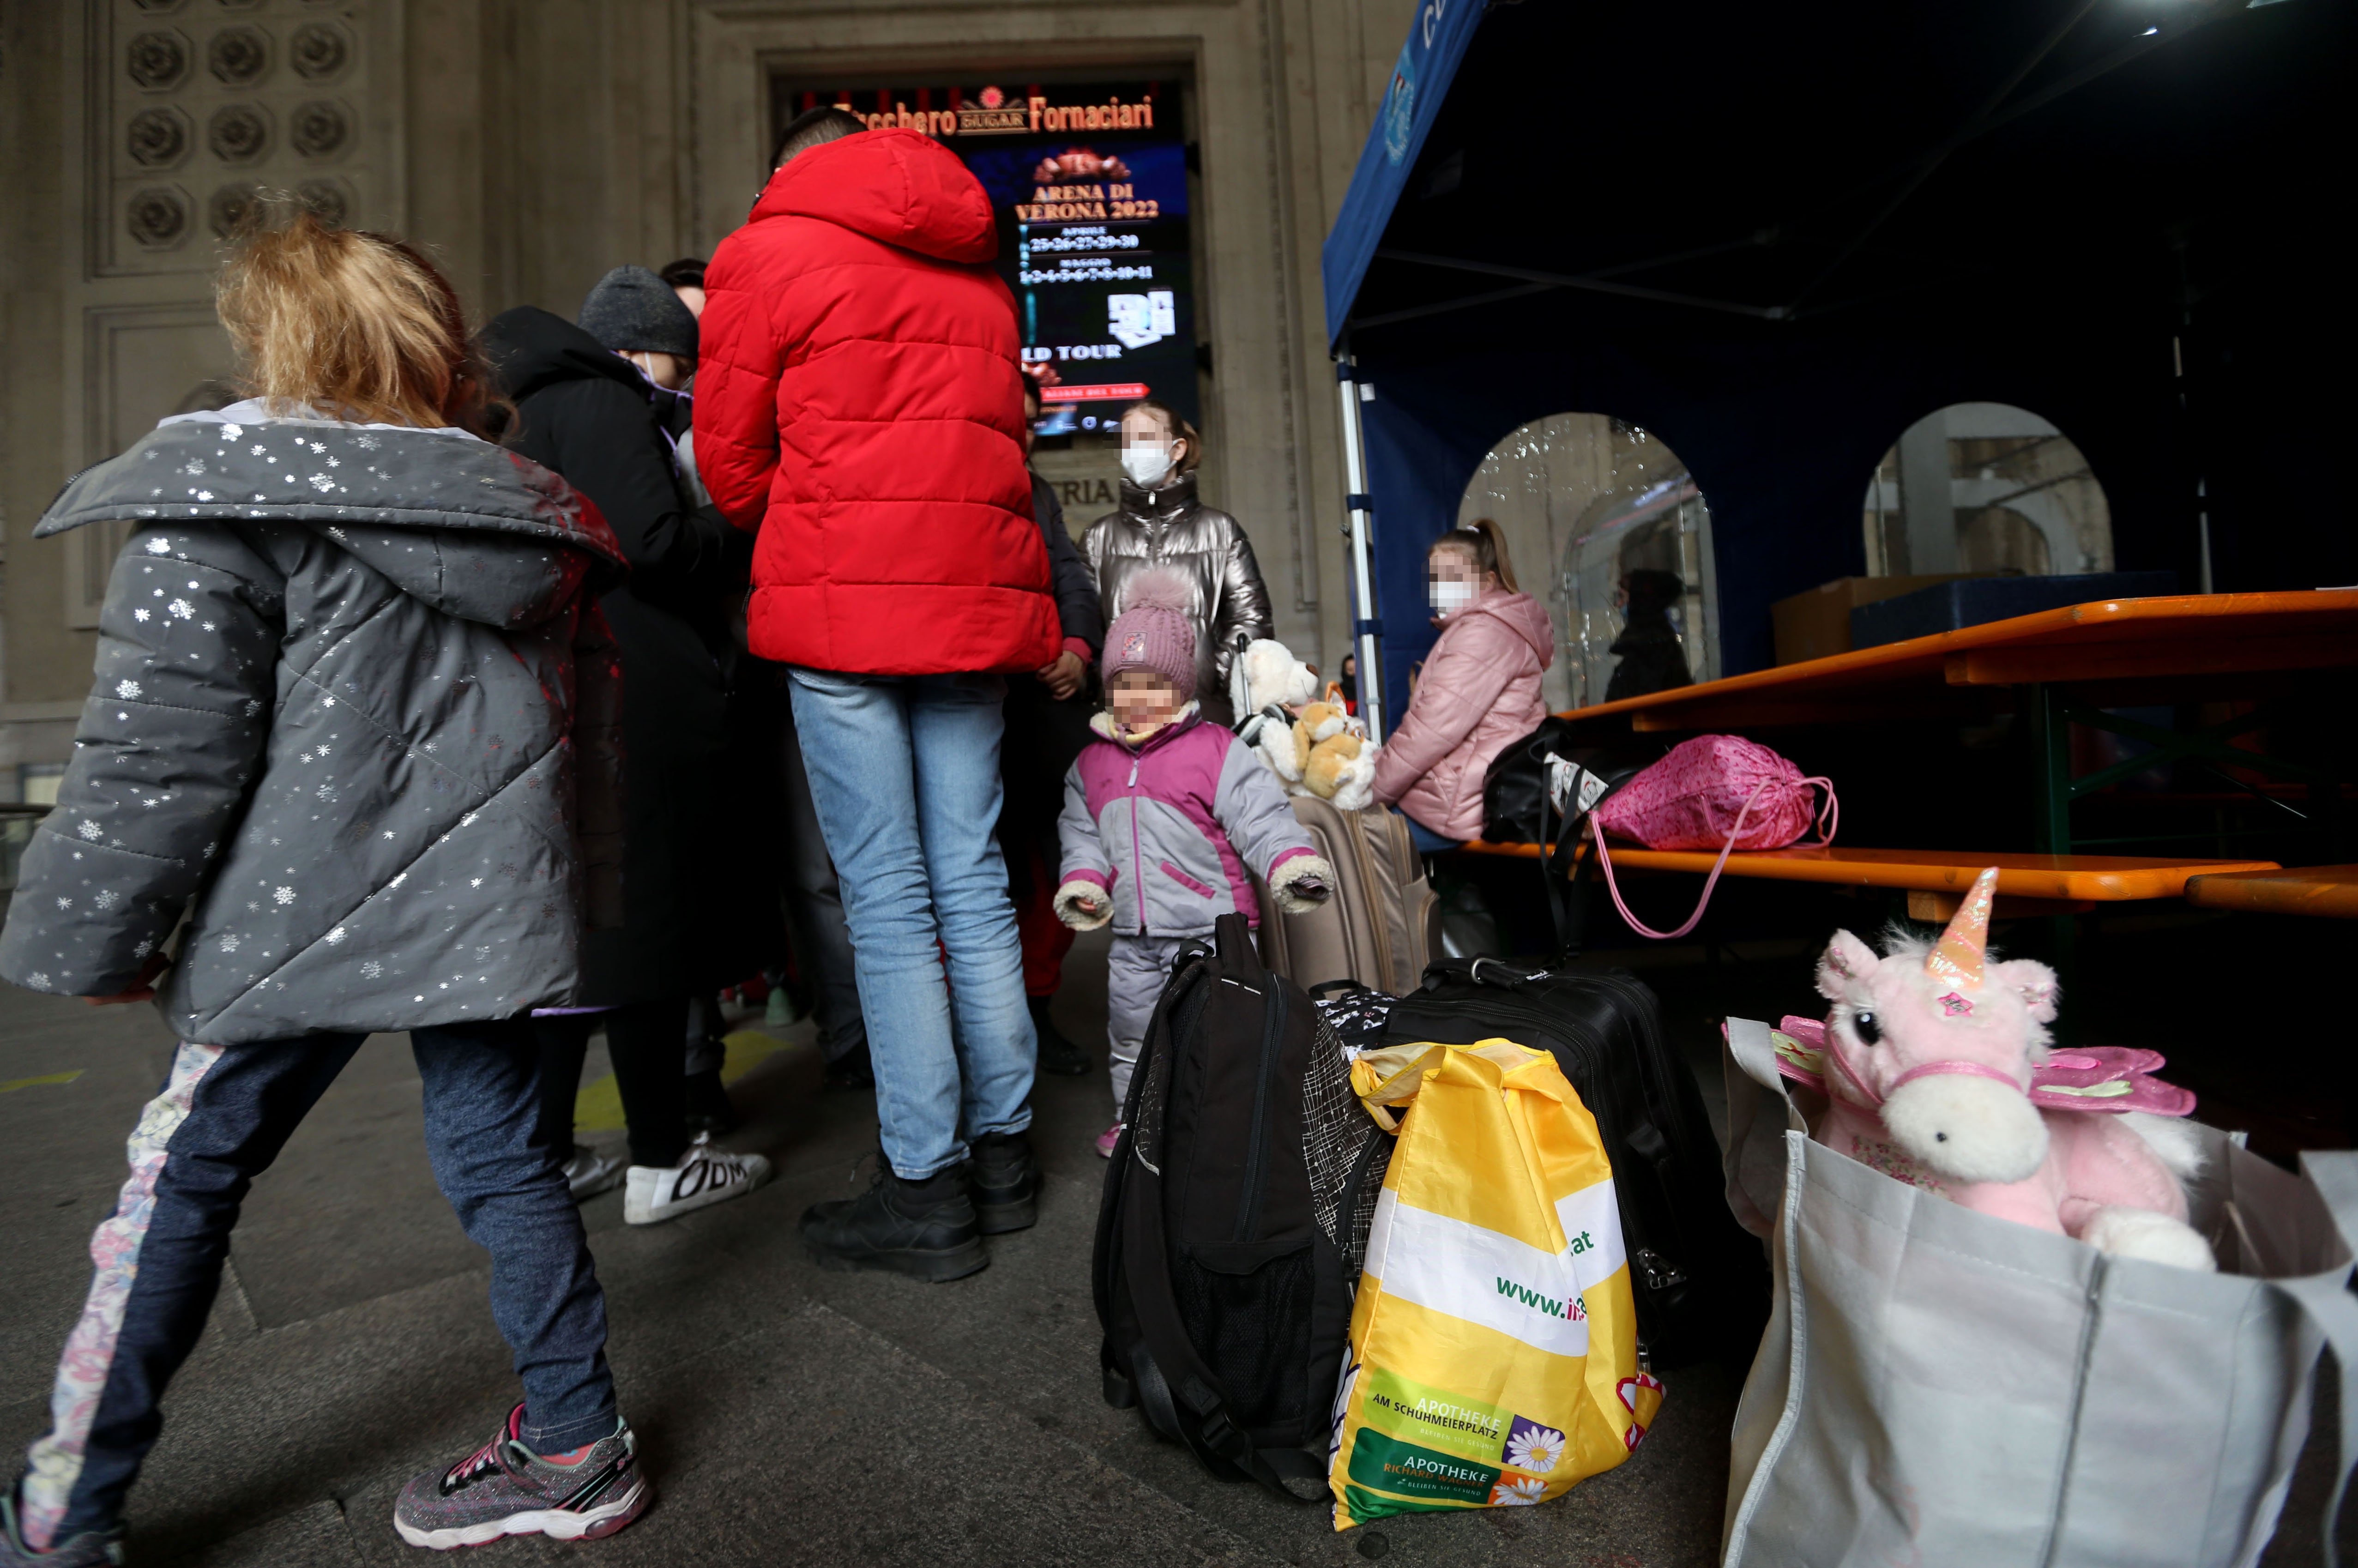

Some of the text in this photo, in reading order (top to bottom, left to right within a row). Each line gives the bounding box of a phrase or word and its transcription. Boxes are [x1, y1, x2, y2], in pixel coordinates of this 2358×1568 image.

[833, 95, 1153, 136] cchero SUGAR Fornaciari
[1032, 183, 1134, 202] ARENA DI
[1015, 200, 1159, 222] VERONA 2022
[1055, 344, 1122, 361] TOUR
[1373, 1393, 1498, 1440] AM SCHUHMEIERPLATZ
[1416, 1398, 1501, 1432] APOTHEKE
[1420, 1428, 1451, 1441] BLEIBEN
[1468, 1439, 1495, 1451] GESUND
[1384, 1463, 1485, 1488] RICHARD WAGNER
[1404, 1456, 1489, 1483] APOTHEKE
[1408, 1481, 1437, 1490] BLEIBEN
[1453, 1486, 1481, 1496] GESUND
